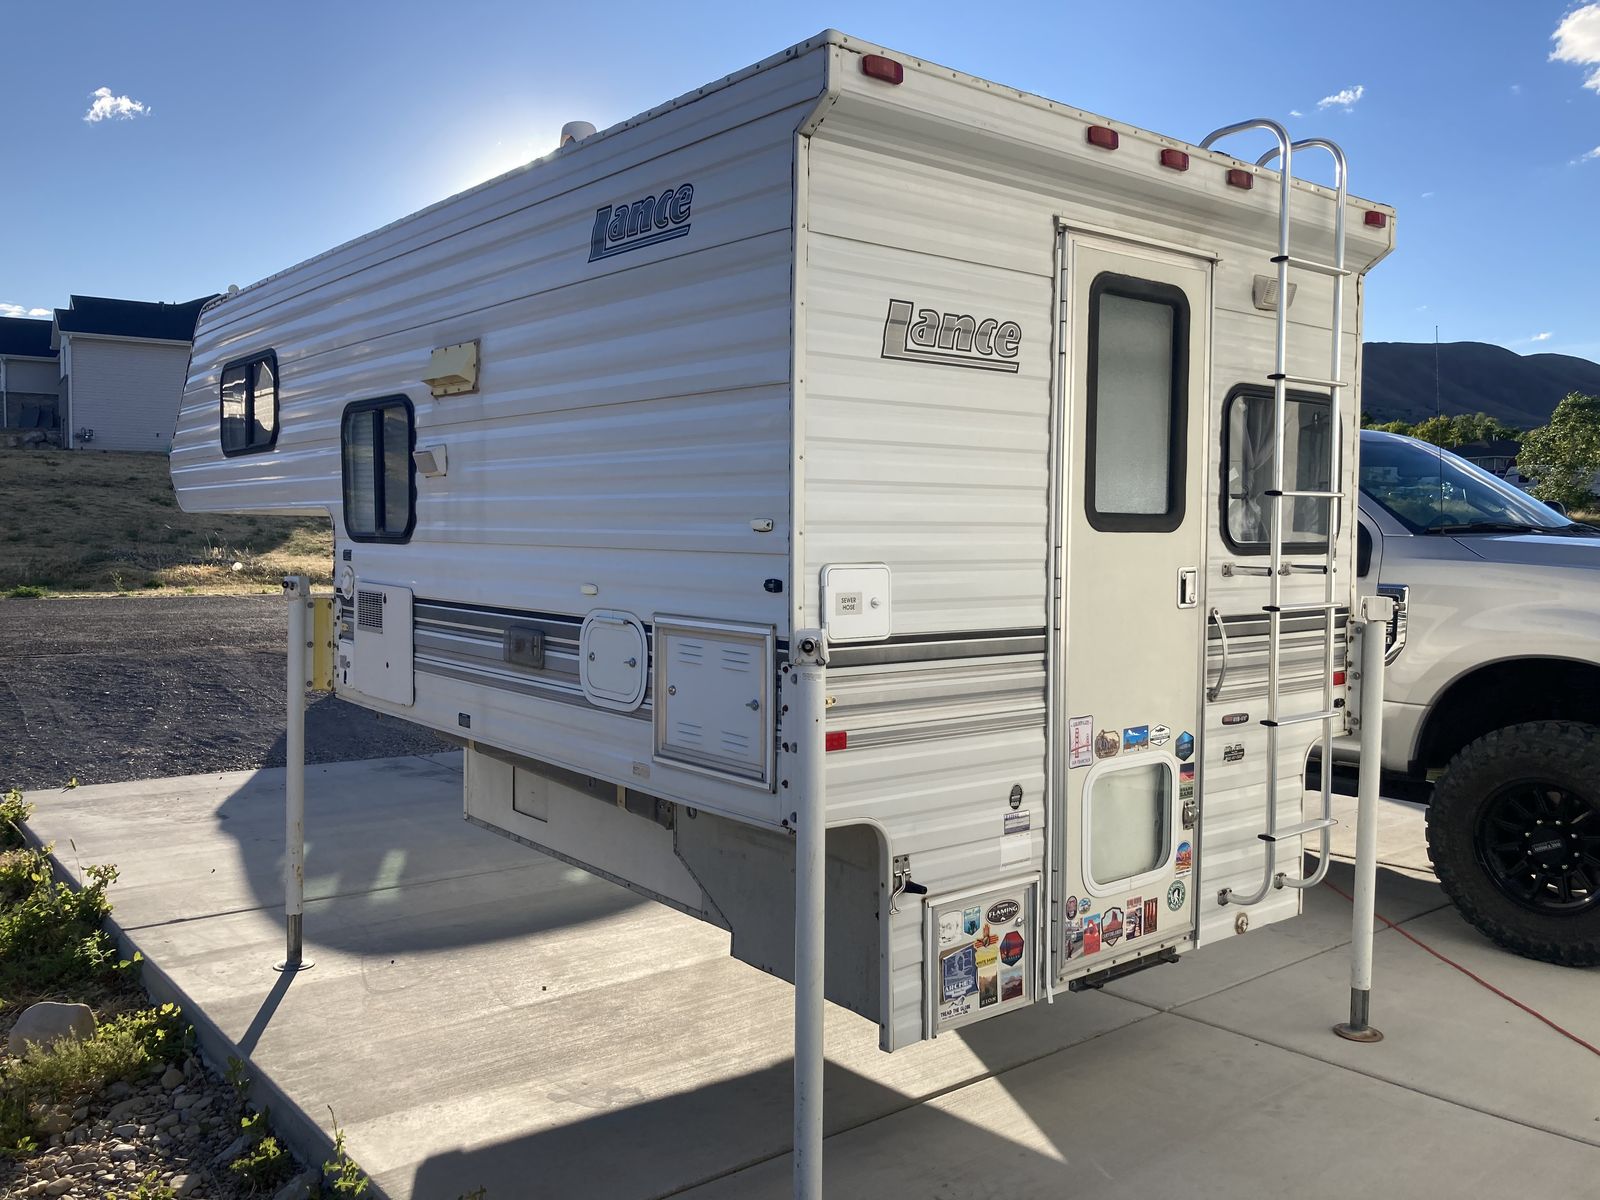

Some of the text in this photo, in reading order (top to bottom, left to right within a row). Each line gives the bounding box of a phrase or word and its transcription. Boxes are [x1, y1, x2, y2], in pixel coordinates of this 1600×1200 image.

[588, 183, 694, 263] Lance
[881, 298, 1022, 374] Lance
[989, 905, 1018, 918] FLAMING
